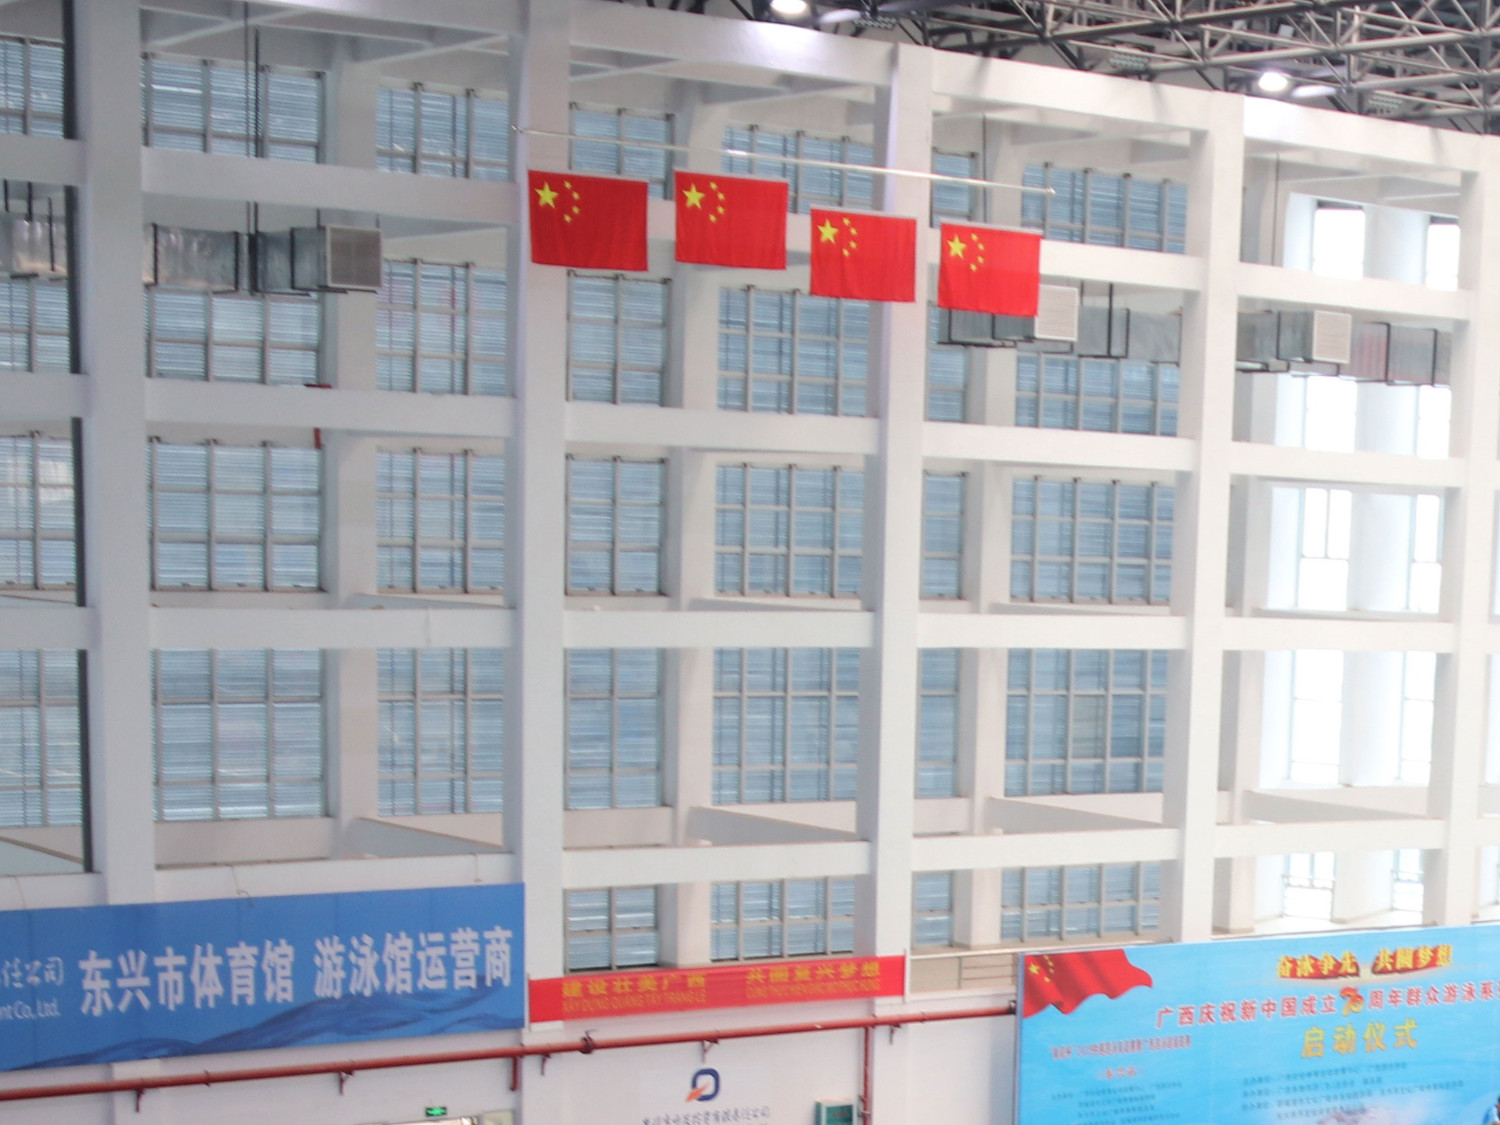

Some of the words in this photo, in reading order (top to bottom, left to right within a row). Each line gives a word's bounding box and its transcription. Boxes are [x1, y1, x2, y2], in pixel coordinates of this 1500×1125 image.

[78, 938, 295, 1017] 东兴市体育馆
[313, 925, 513, 1000] 游泳馆运营商
[1301, 1017, 1419, 1058] 启动仪式
